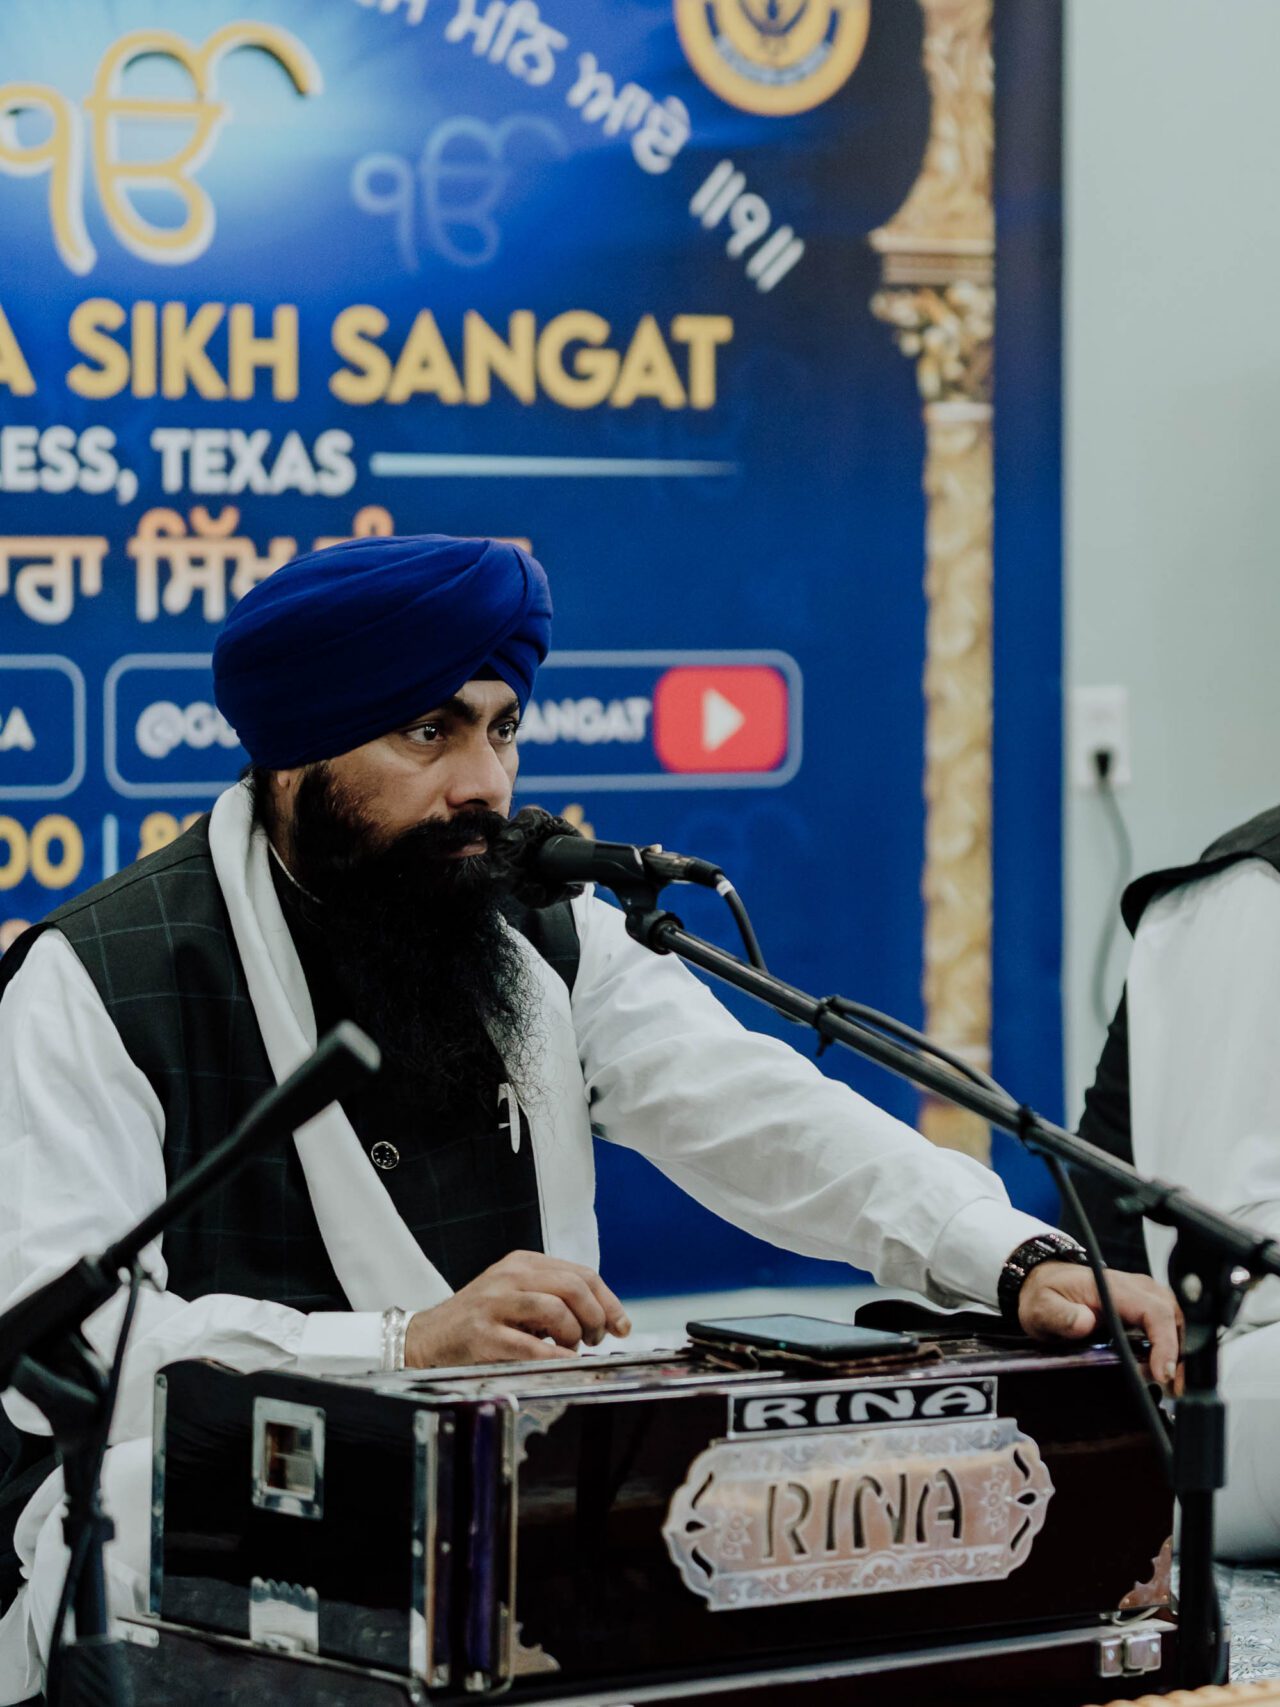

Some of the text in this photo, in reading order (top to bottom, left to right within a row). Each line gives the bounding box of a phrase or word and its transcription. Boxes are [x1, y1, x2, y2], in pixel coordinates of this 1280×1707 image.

[66, 297, 299, 402] SIKH
[328, 304, 734, 411] SANGAT
[151, 428, 357, 497] TEXAS
[742, 1385, 989, 1430] RINA
[763, 1468, 964, 1563] RINA
